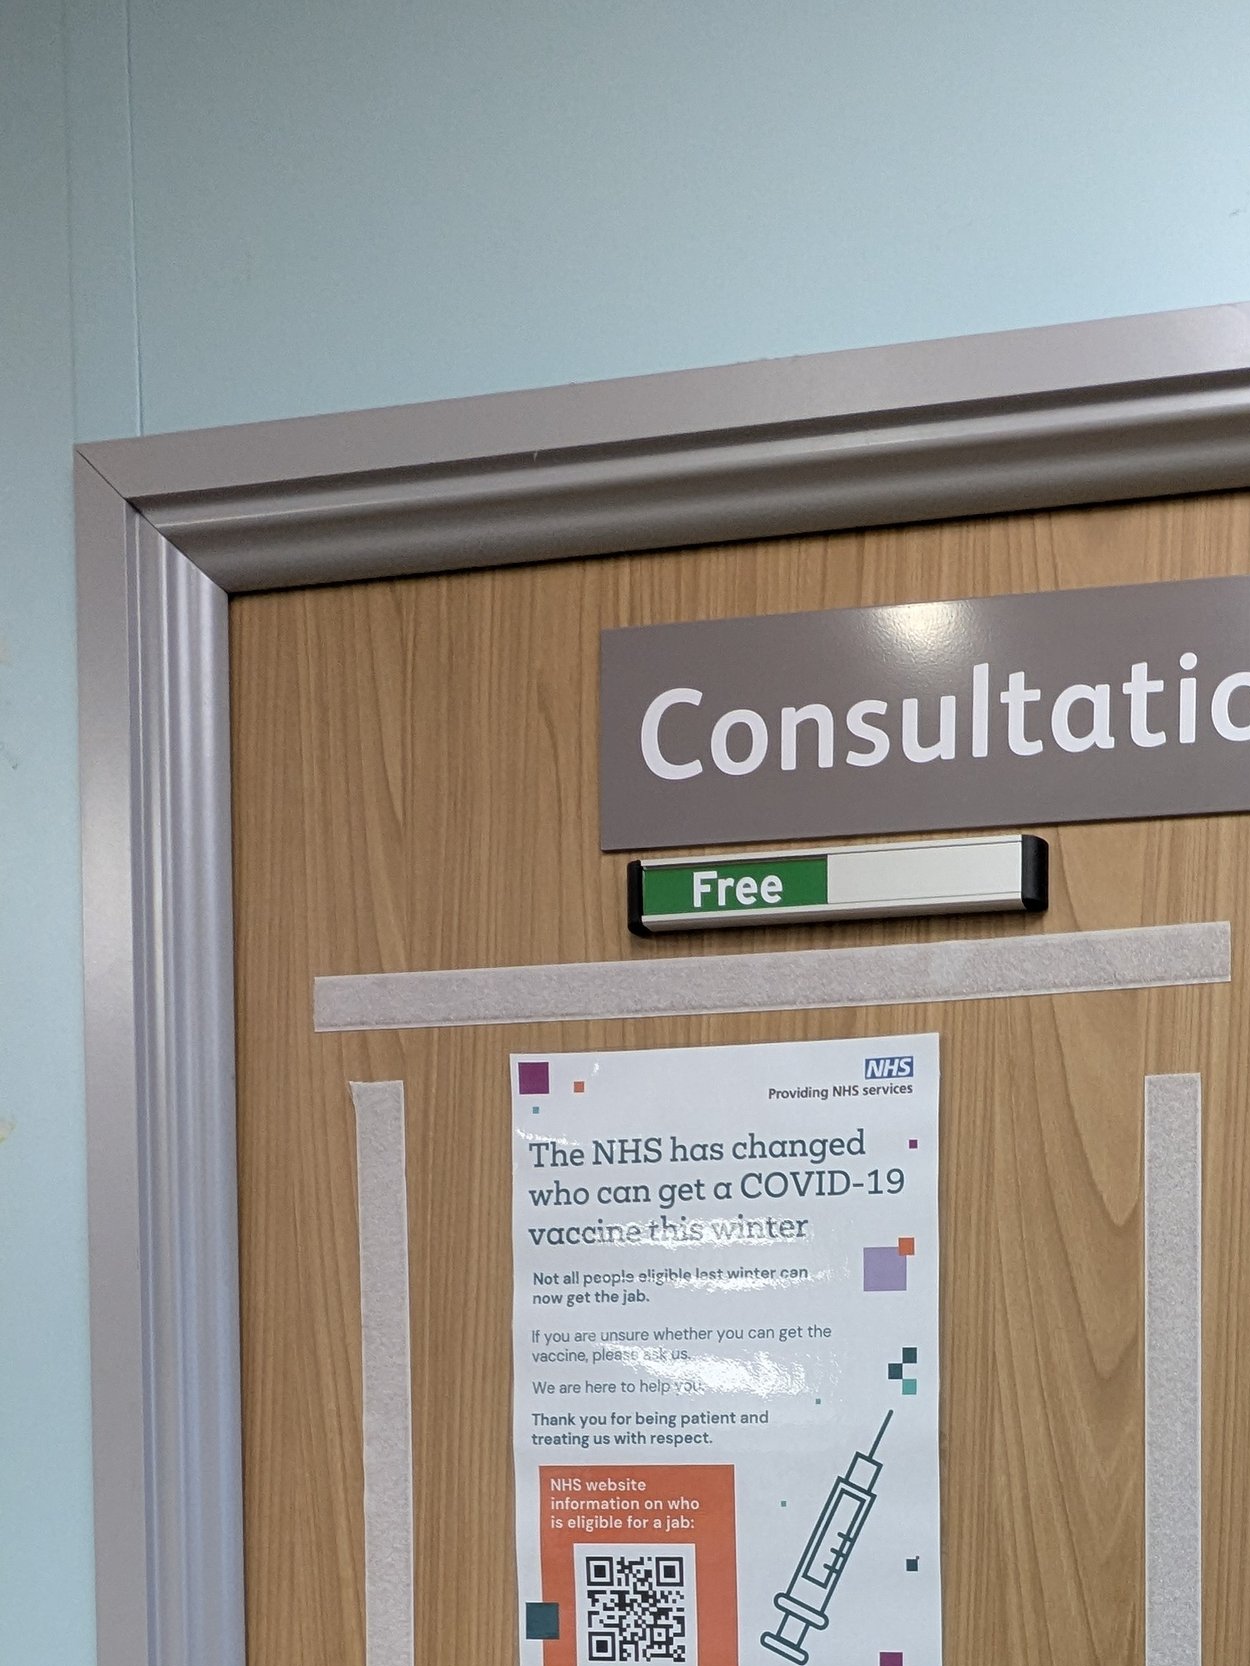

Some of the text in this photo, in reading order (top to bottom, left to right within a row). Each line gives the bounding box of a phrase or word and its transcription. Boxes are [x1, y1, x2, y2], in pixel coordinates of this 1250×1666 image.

[691, 869, 784, 908] Free
[866, 1058, 912, 1077] NHS
[768, 1082, 913, 1100] Providing NHS services
[528, 1128, 866, 1168] The NHS has changed
[528, 1168, 904, 1209] who can get a COVID-19
[529, 1214, 808, 1245] vaccine this winter
[531, 1409, 768, 1429] Thank you for being patient and
[531, 1430, 712, 1448] treating us with respect.
[550, 1477, 646, 1491] NHS website
[551, 1496, 699, 1510] information on who
[551, 1515, 694, 1532] is eligible for a jab:
